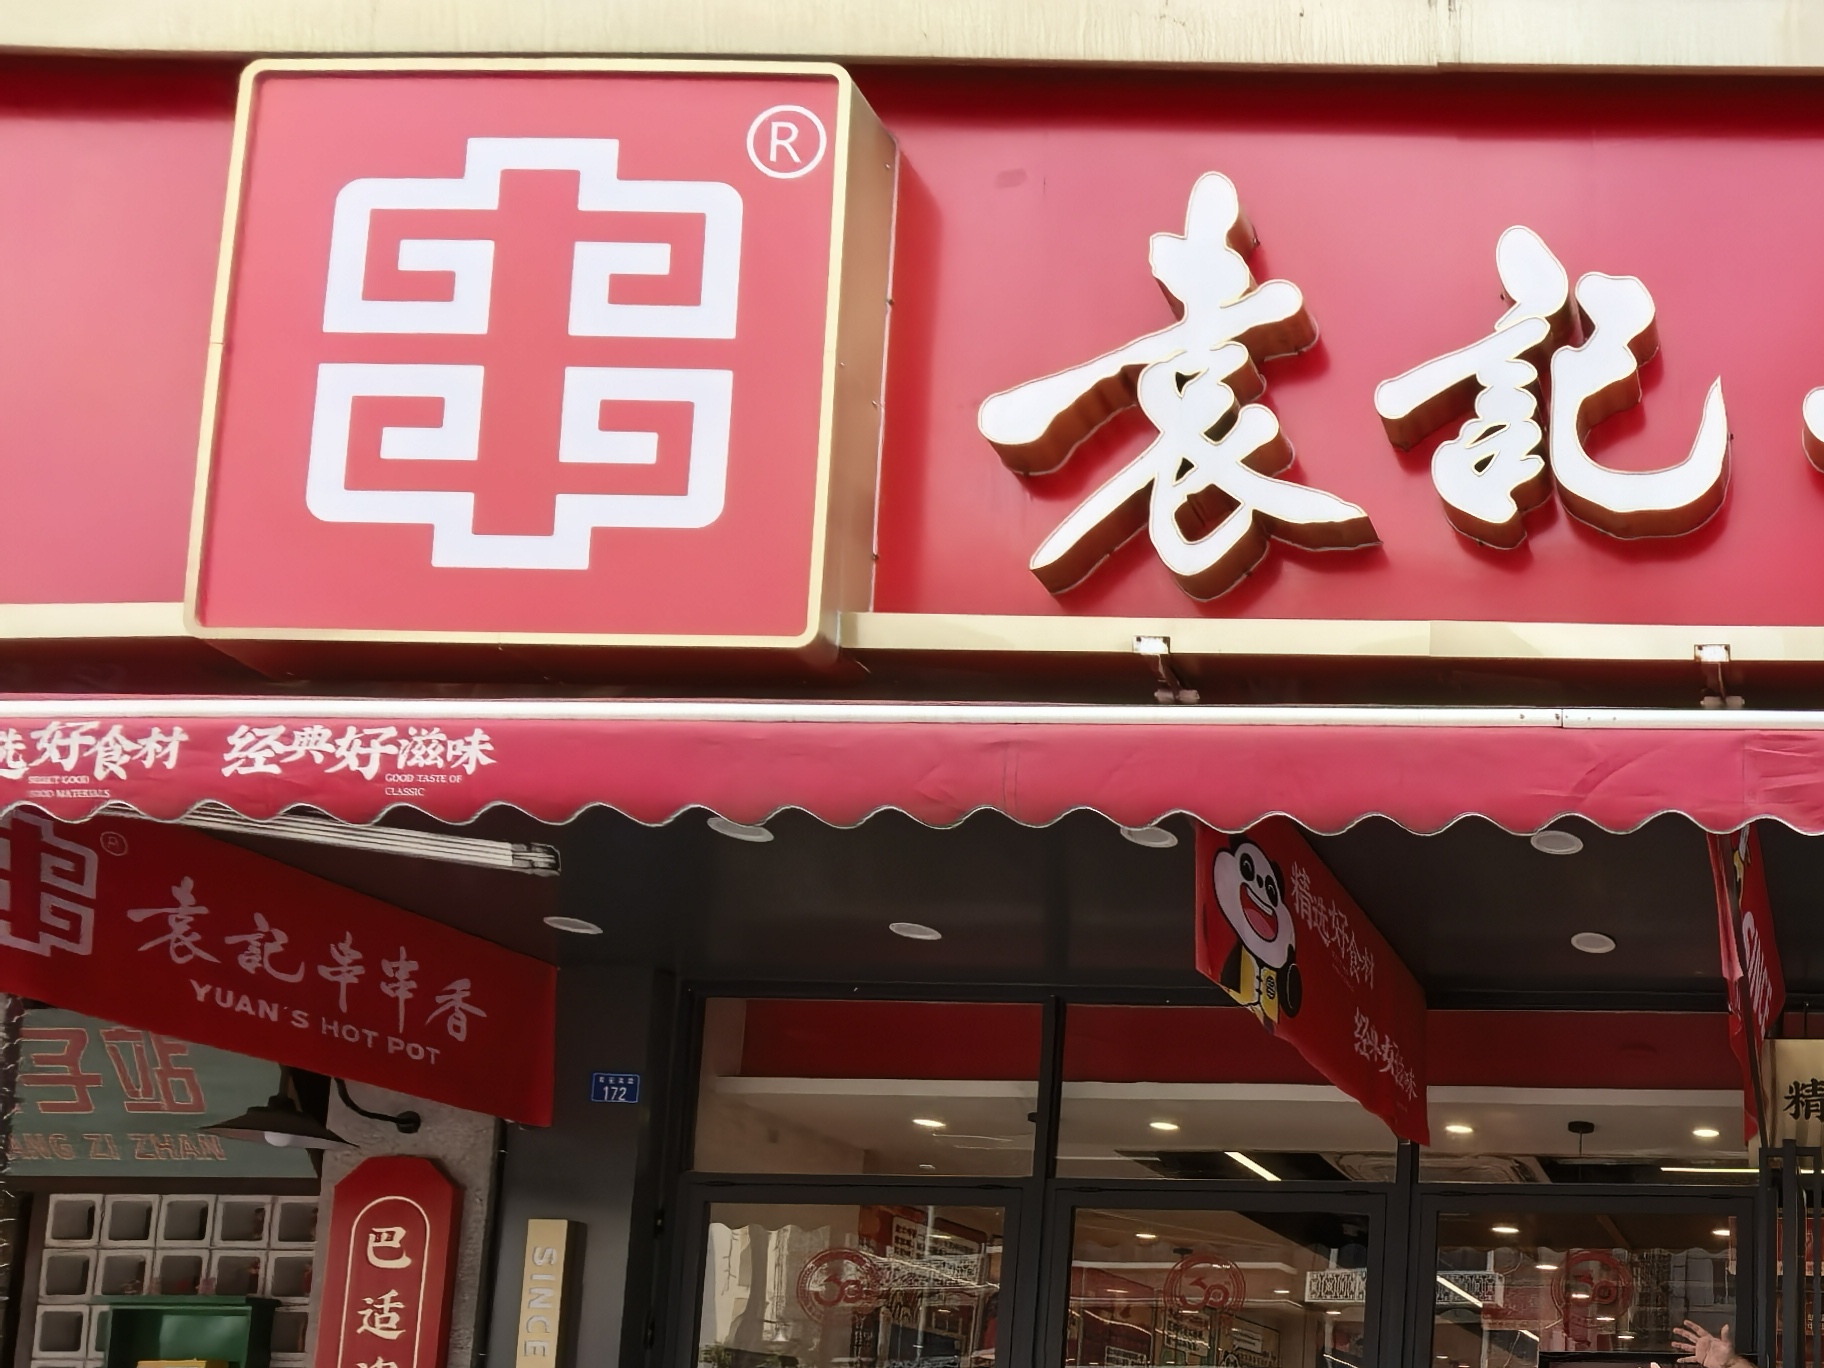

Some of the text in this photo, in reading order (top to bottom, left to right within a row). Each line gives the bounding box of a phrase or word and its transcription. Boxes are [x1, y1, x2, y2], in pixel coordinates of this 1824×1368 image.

[223, 724, 497, 779] 经典好滋味
[189, 979, 441, 1065] YUAN'S HOT POT
[603, 1086, 627, 1101] 172
[88, 1134, 120, 1160] ZI
[135, 1133, 225, 1161] ZHAN
[519, 1246, 557, 1358] SINCE
